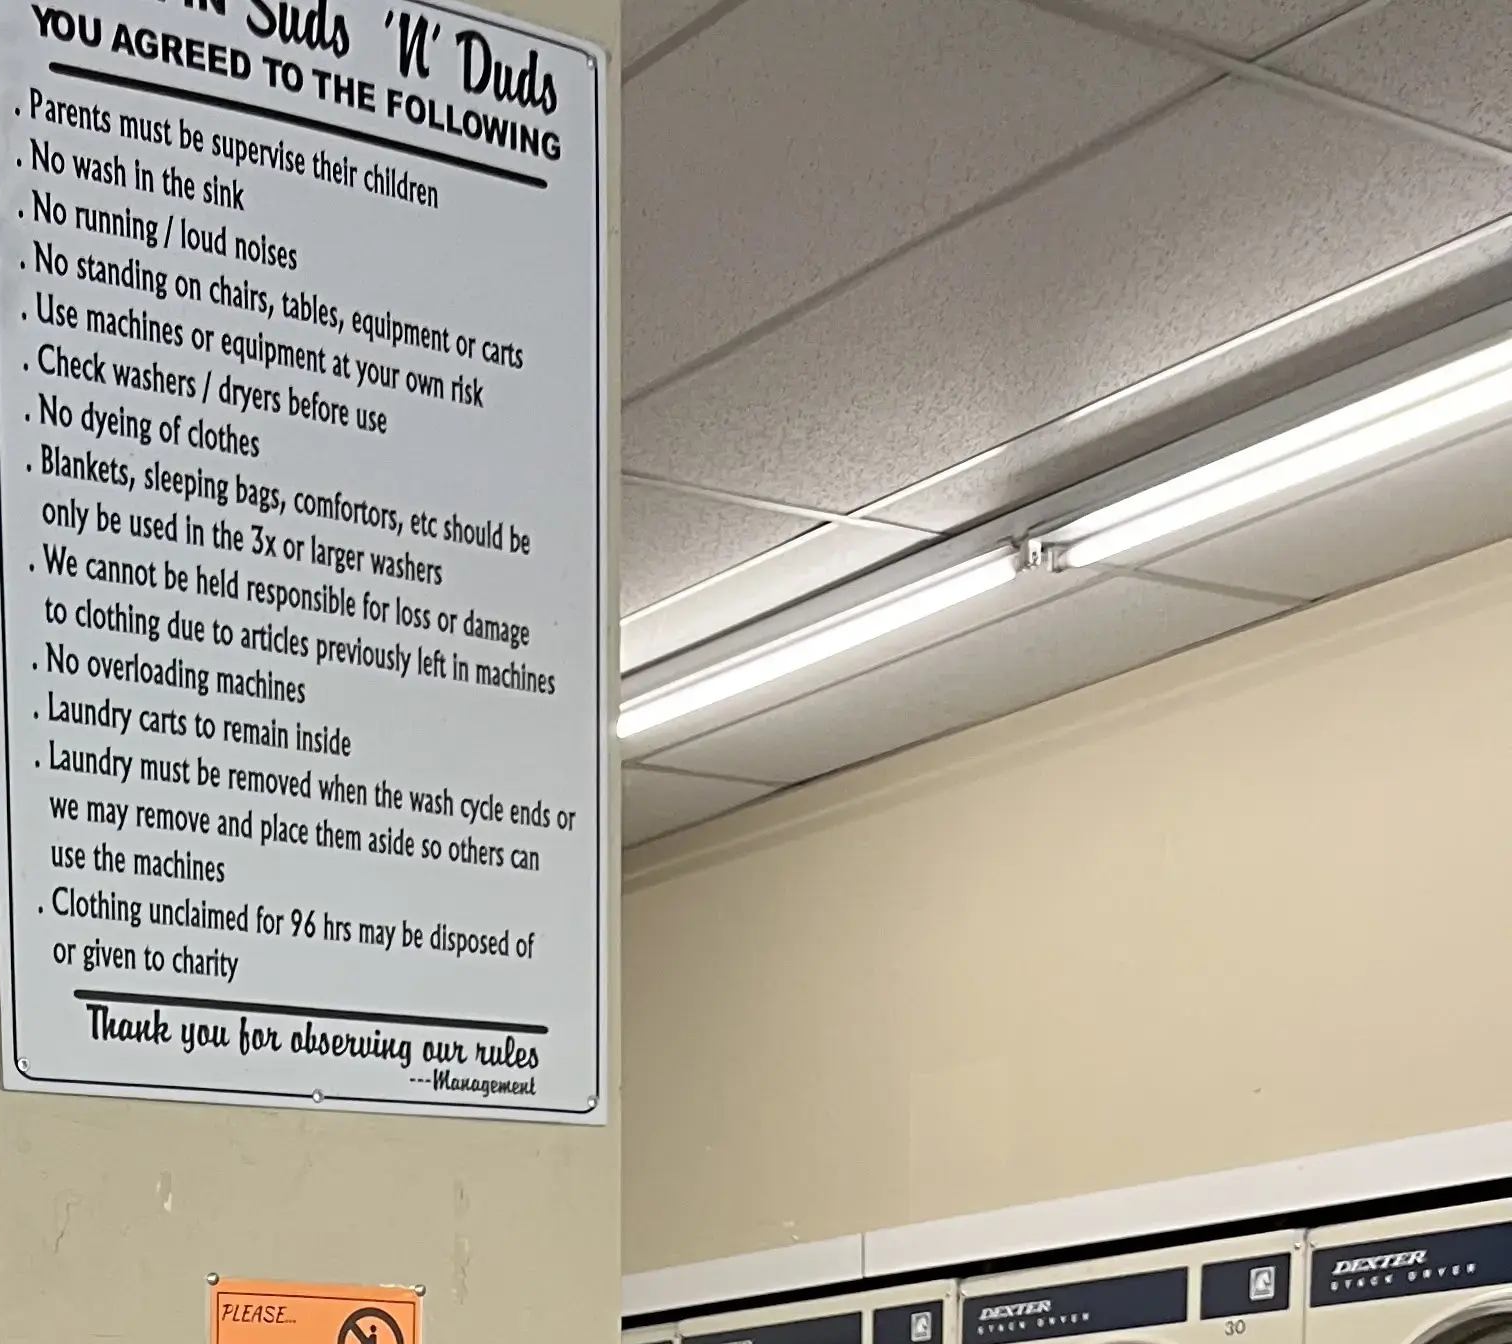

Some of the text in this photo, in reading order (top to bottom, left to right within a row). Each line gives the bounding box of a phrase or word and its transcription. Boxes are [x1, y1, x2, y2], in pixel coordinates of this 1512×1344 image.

[30, 2, 561, 162] YOU AGREED TO THE FOLLOWING
[246, 0, 350, 59] Suds
[455, 30, 557, 115] Duds
[28, 136, 245, 211] No wash in the sink
[29, 86, 439, 209] Parents must be supervise their children
[30, 188, 298, 271] No running loud noises
[31, 238, 524, 370] No standing on chairs, tables, equipment carts
[35, 290, 484, 409] Use machines equipment your own risk
[36, 342, 387, 435] Check washers dryers before use
[37, 391, 260, 458] No dyeing of clothes
[39, 442, 531, 556] Blankets, sleeping bags, comfortors, etc should be
[41, 496, 443, 586] only be used the 3x larger washers
[41, 541, 530, 650] We cannot be held responsible for loss damage
[43, 595, 556, 696] to clothing due articles previously left machines
[44, 640, 306, 704] No overloading machines
[47, 689, 351, 757] Laundry carts remain inside
[48, 738, 551, 828] Laundry must be removed when the wash cycle ends
[48, 795, 540, 872] we may remove and place them aside others can
[49, 840, 225, 884] use the machines
[51, 885, 509, 958] Clothing unclaimed for 96 hrs may be disposed
[82, 937, 239, 984] given charity
[85, 1002, 539, 1069] Thank you for observing our rules
[1331, 1249, 1429, 1276] DEXTER
[978, 1299, 1052, 1321] DEXTER
[1224, 1319, 1246, 1336] 30
